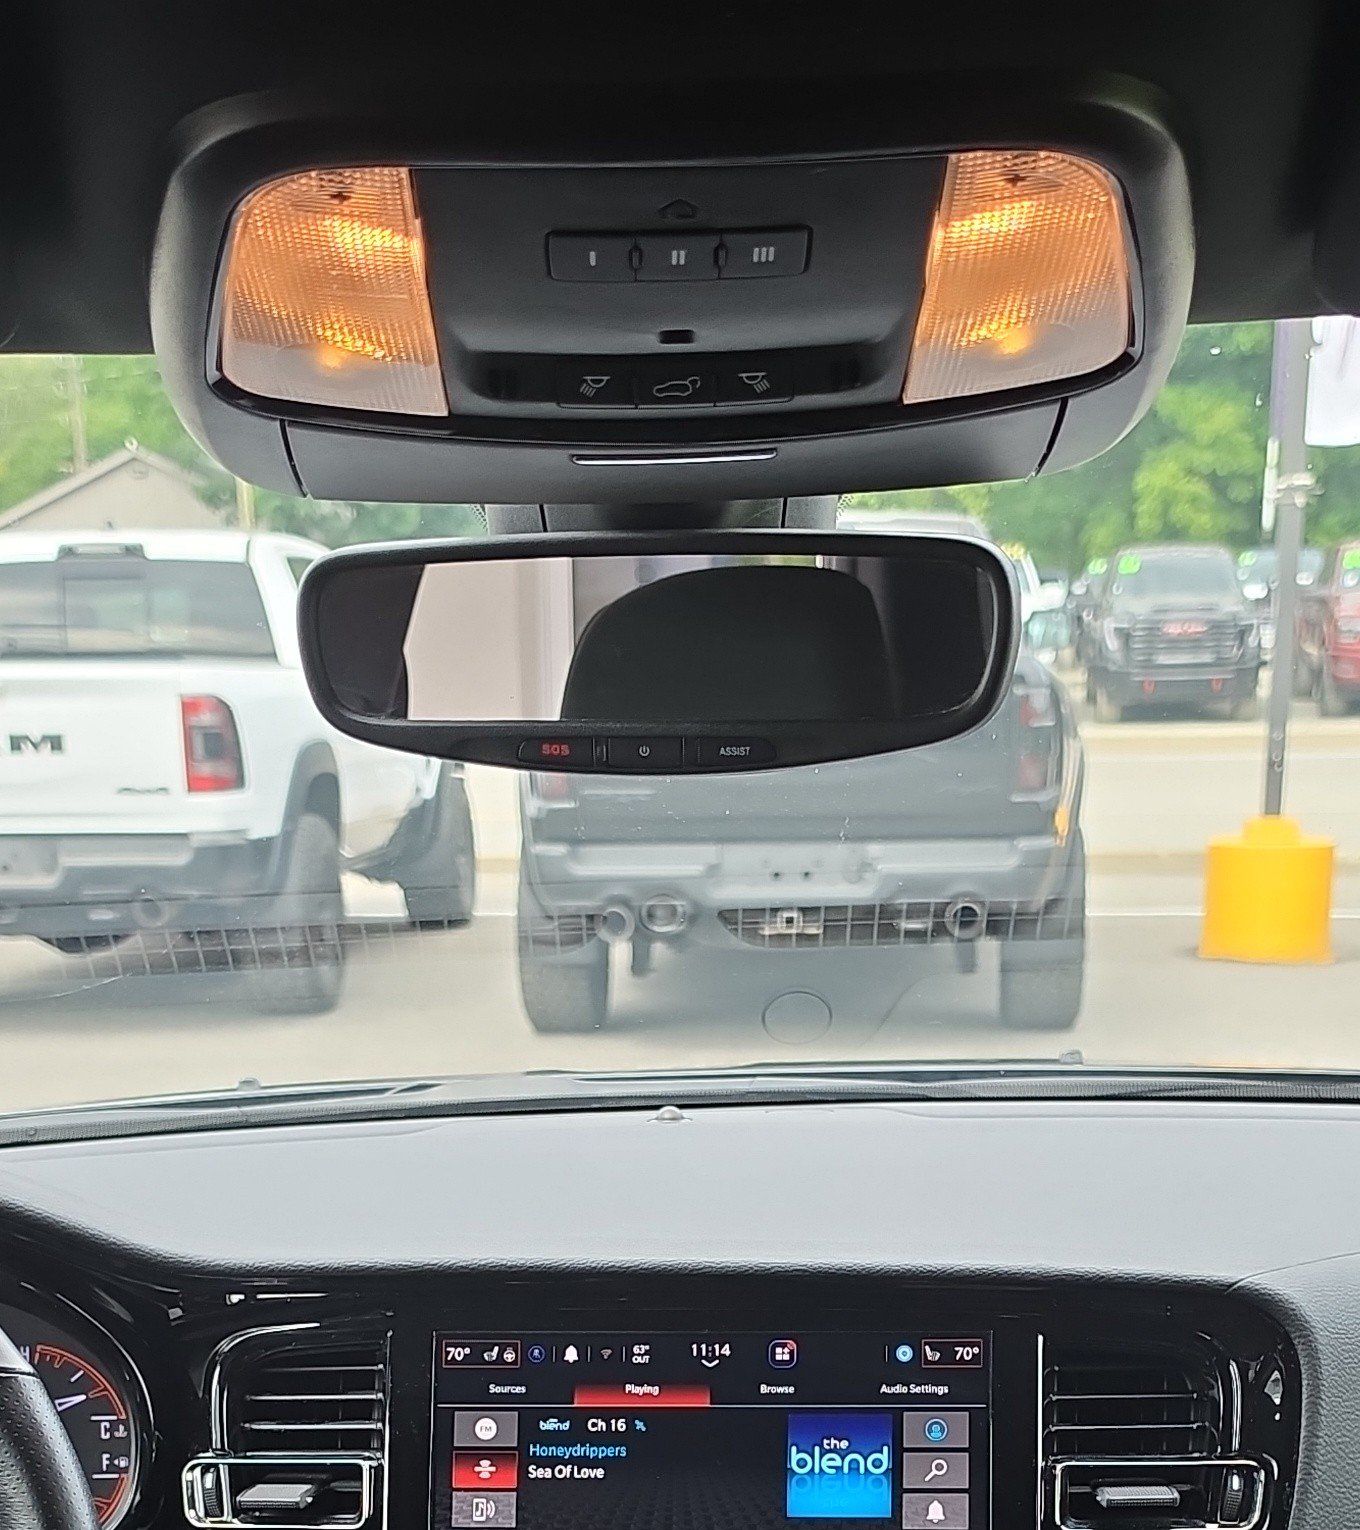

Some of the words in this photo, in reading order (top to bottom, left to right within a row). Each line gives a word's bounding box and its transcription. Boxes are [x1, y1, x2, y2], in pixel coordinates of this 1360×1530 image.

[542, 744, 570, 756] SOS
[719, 746, 751, 757] ASSIST
[446, 1346, 471, 1362] 70°
[632, 1344, 650, 1356] 63°
[691, 1342, 731, 1358] 11:14
[954, 1346, 980, 1361] 70°
[632, 1355, 651, 1364] OUT
[488, 1383, 527, 1395] Sources
[624, 1383, 660, 1397] Playing
[760, 1383, 795, 1395] Browse
[879, 1383, 908, 1395] Audio
[909, 1383, 949, 1397] Settings
[100, 1421, 111, 1440] C
[479, 1425, 494, 1434] FM
[586, 1418, 608, 1433] Ch
[610, 1418, 627, 1432] 16
[823, 1436, 850, 1450] the
[529, 1442, 628, 1460] Honeydrippers
[101, 1453, 112, 1472] F
[789, 1445, 890, 1476] blend
[527, 1465, 552, 1480] Sea
[554, 1465, 573, 1480] Of
[573, 1465, 606, 1480] Love
